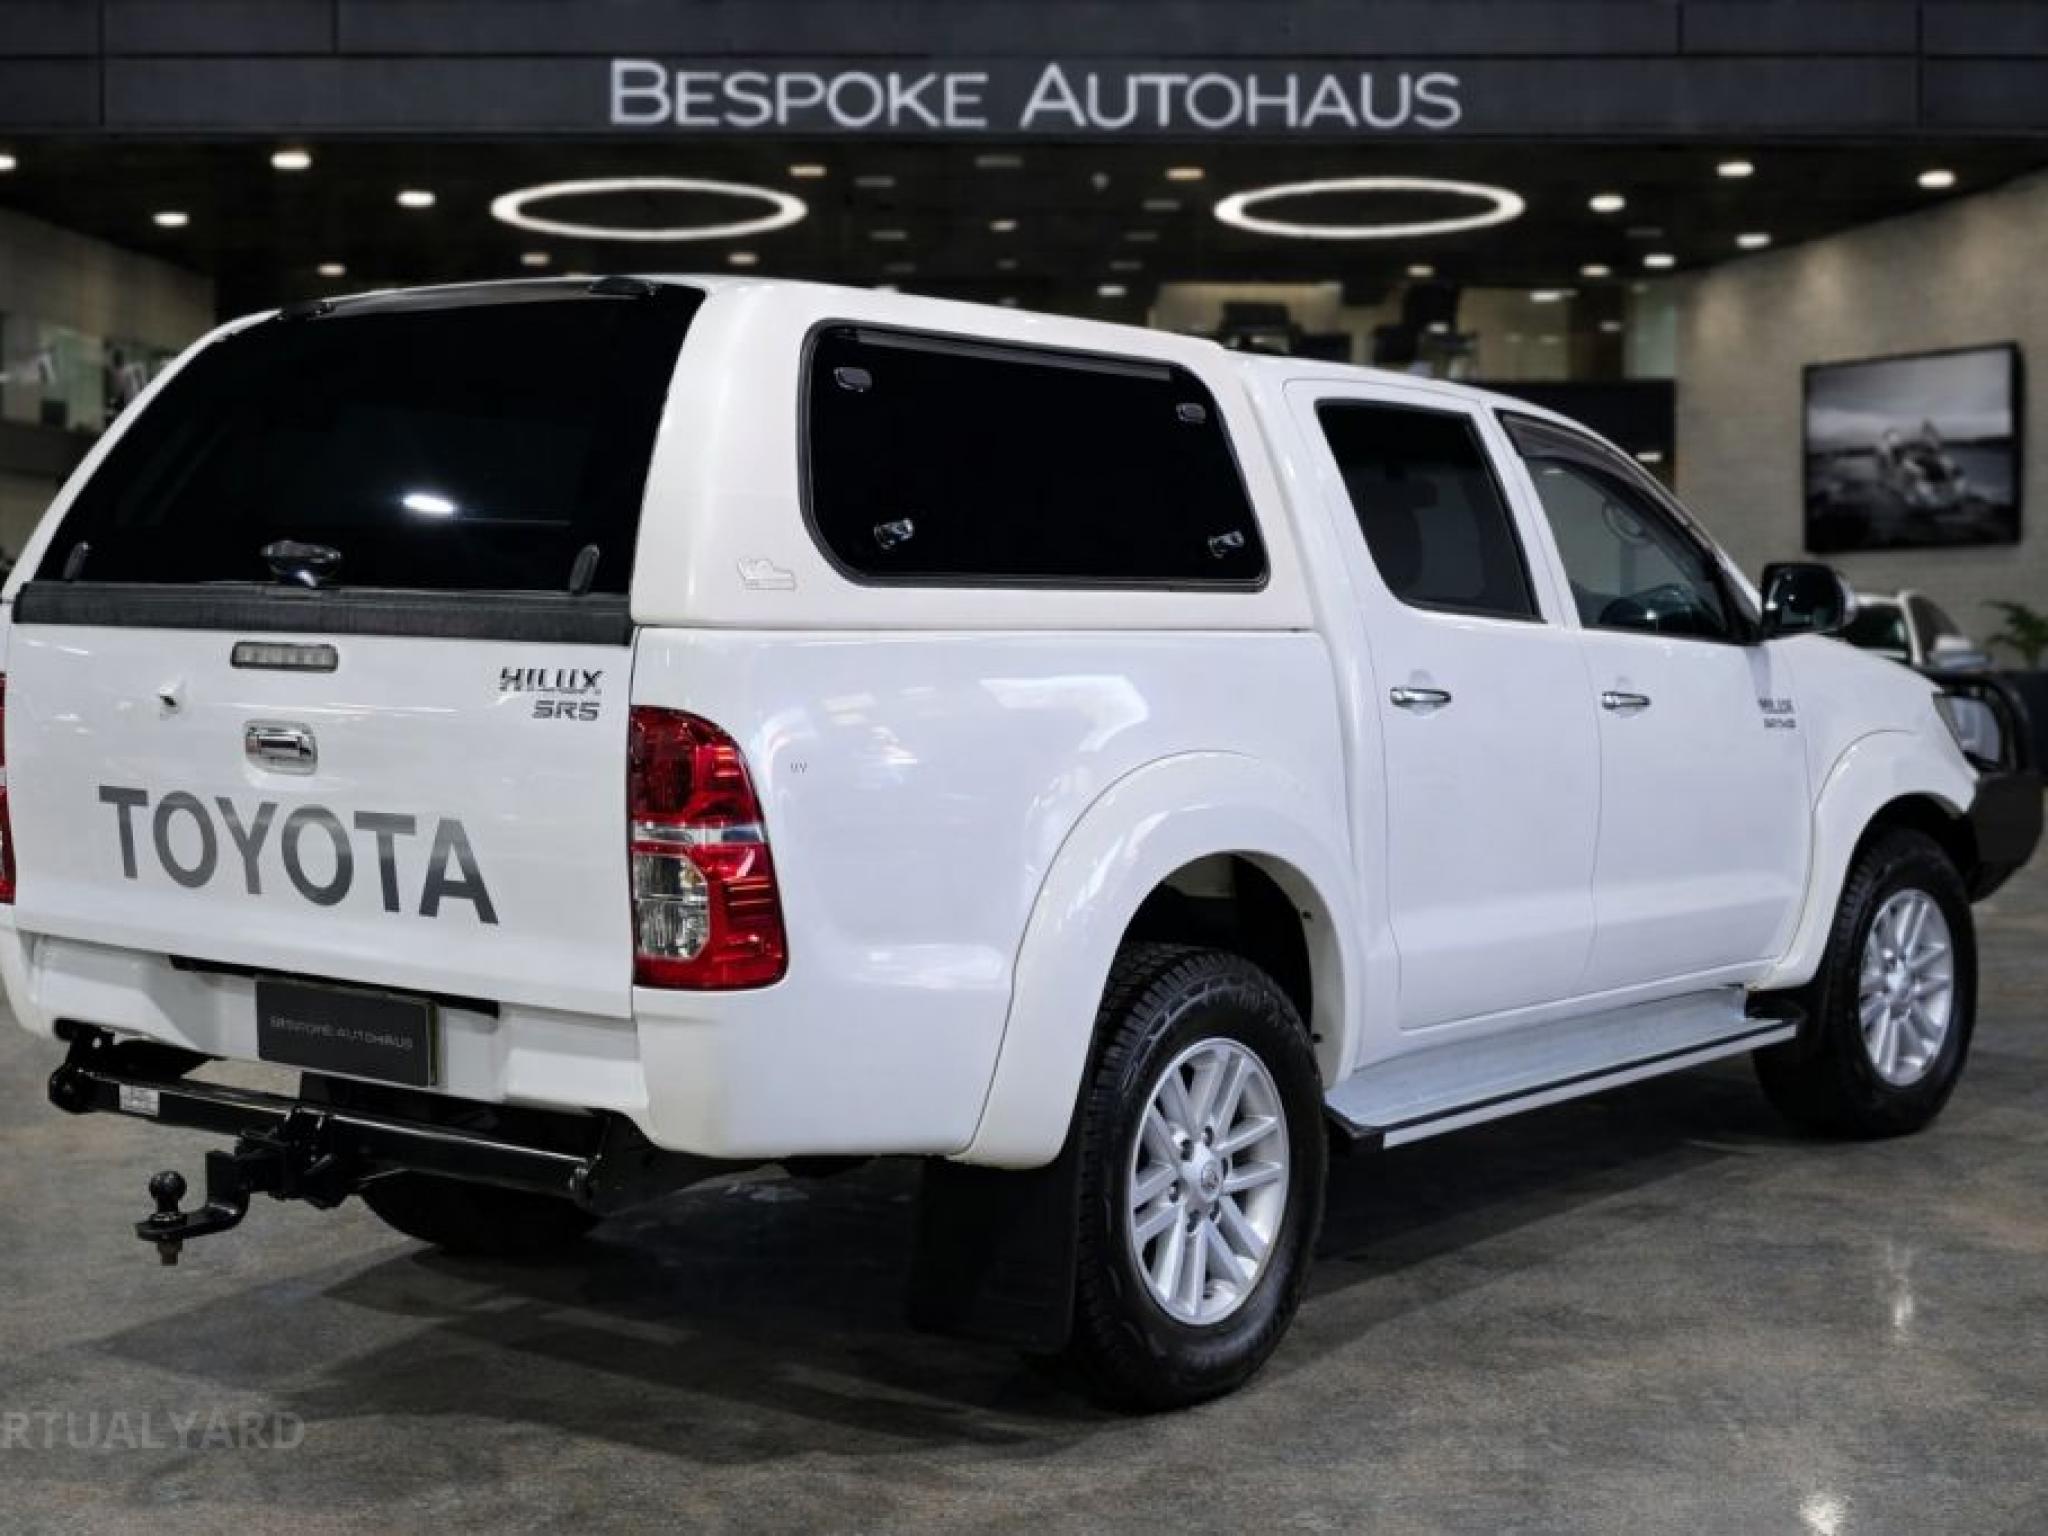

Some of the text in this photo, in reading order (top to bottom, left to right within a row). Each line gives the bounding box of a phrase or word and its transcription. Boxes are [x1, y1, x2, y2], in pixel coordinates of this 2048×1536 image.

[609, 58, 1462, 129] BESPOKE AUTOHAUS
[500, 667, 604, 692] HILUX
[99, 785, 499, 925] TOYOTA
